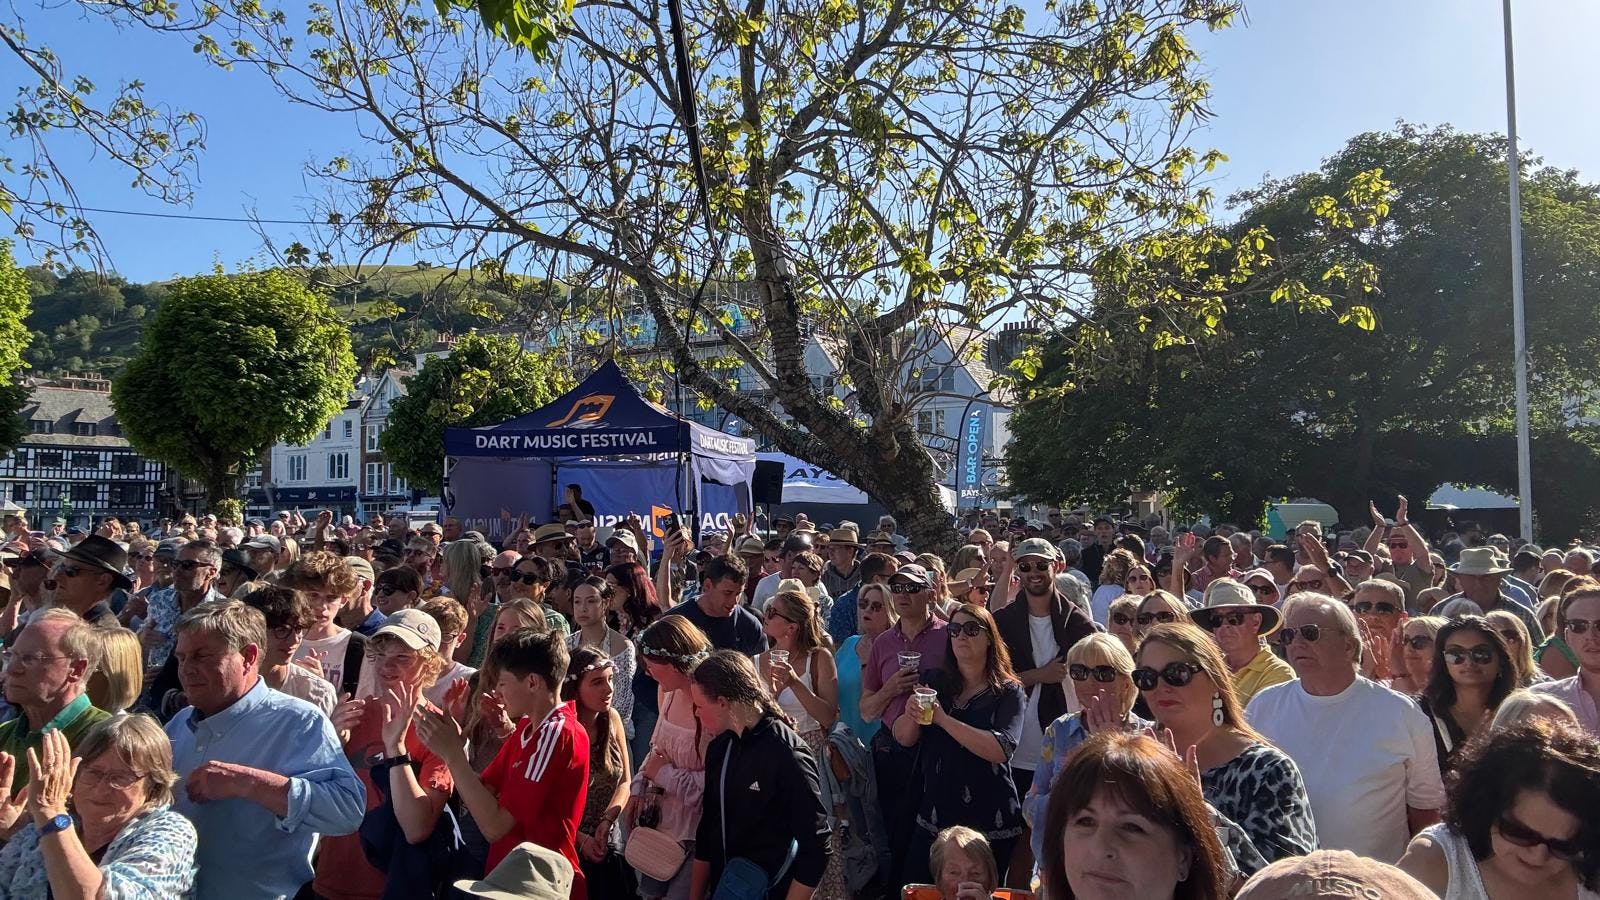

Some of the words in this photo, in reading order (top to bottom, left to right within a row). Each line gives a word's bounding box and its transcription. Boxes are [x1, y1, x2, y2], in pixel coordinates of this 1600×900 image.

[475, 435, 520, 449] DART
[523, 434, 578, 449] MUSIC
[581, 432, 657, 448] FESTIVAL
[700, 434, 714, 450] DART
[968, 417, 980, 454] OPEN
[966, 456, 977, 483] BAR
[961, 489, 979, 498] BAYS
